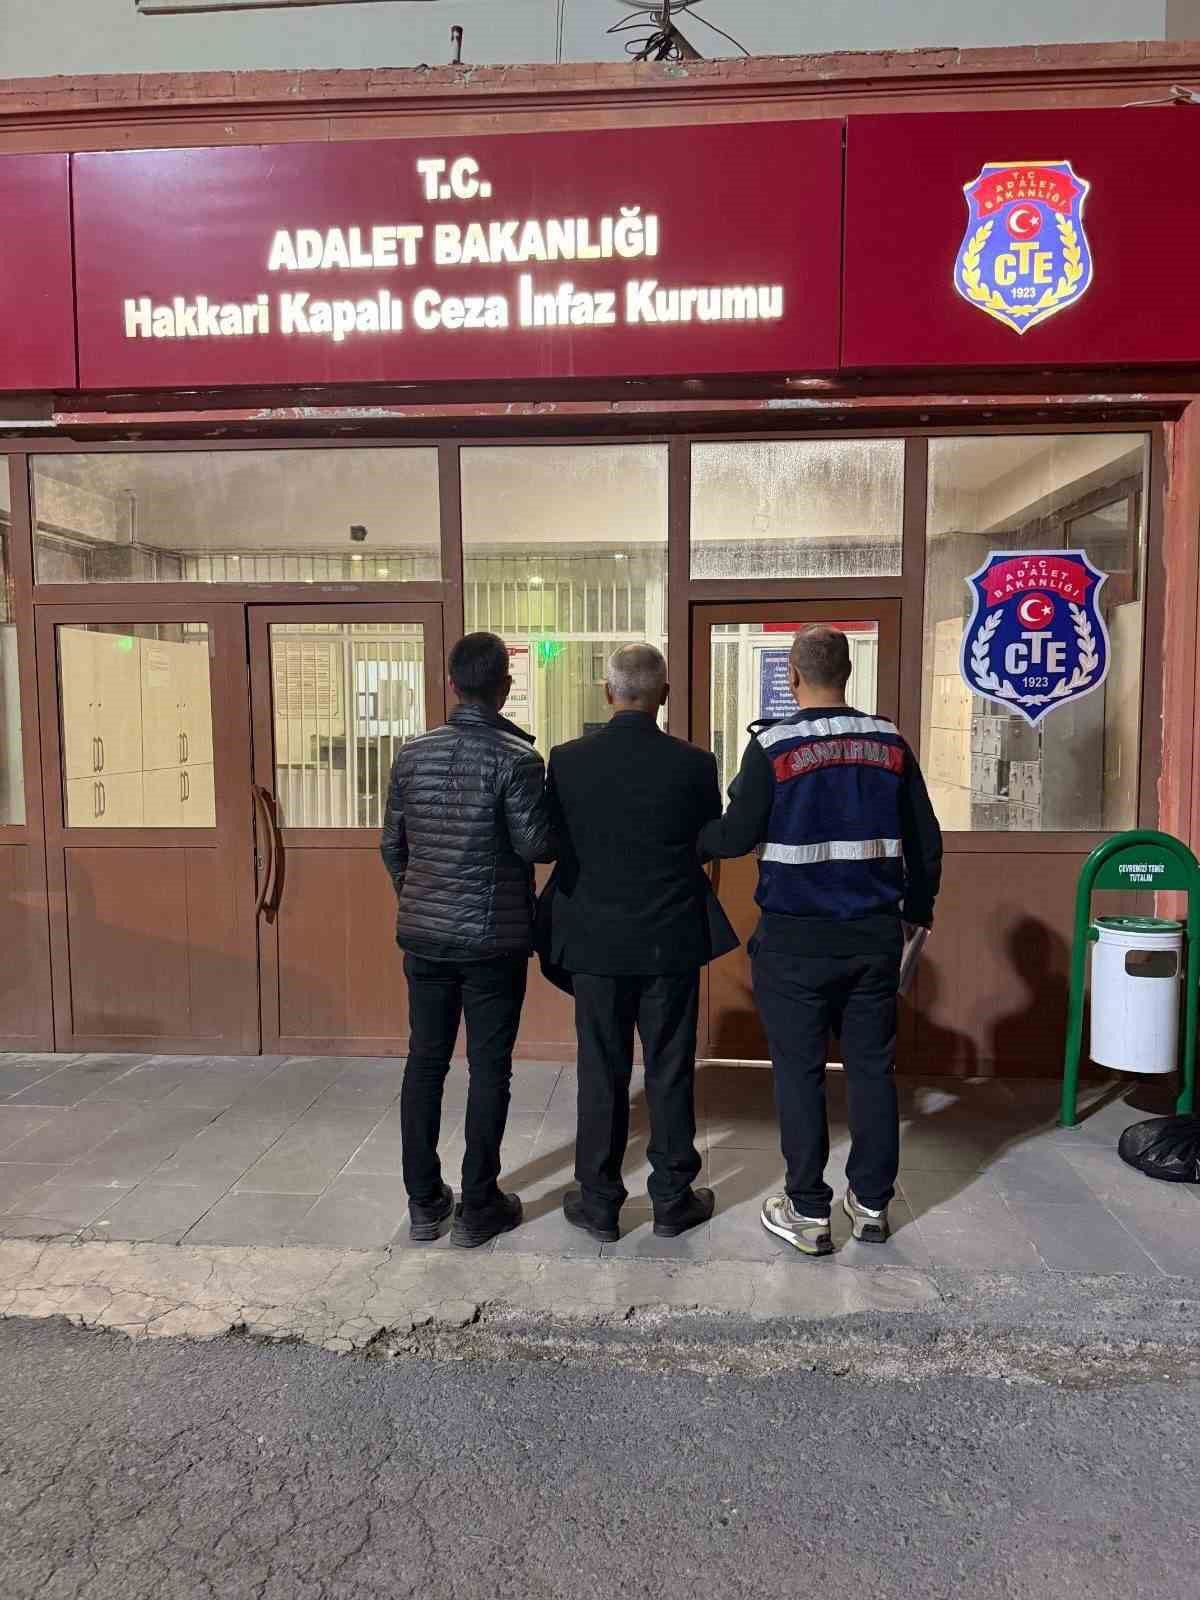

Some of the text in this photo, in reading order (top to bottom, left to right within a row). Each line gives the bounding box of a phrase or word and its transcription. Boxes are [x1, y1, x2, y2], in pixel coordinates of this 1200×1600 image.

[416, 157, 492, 200] T.C.
[995, 179, 1057, 193] ADALET
[267, 205, 658, 271] ADALET BAKANLIĞI
[994, 241, 1054, 286] CTE
[1010, 286, 1036, 299] 1923
[124, 273, 784, 342] Hakkari Kapalı Ceza İnfaz Kurumu
[1005, 568, 1069, 582] ADALET
[993, 578, 1080, 599] BAKANLIĞI
[1005, 631, 1067, 675] CTE
[1022, 676, 1049, 689] 1923
[1129, 873, 1153, 882] TUTALIM
